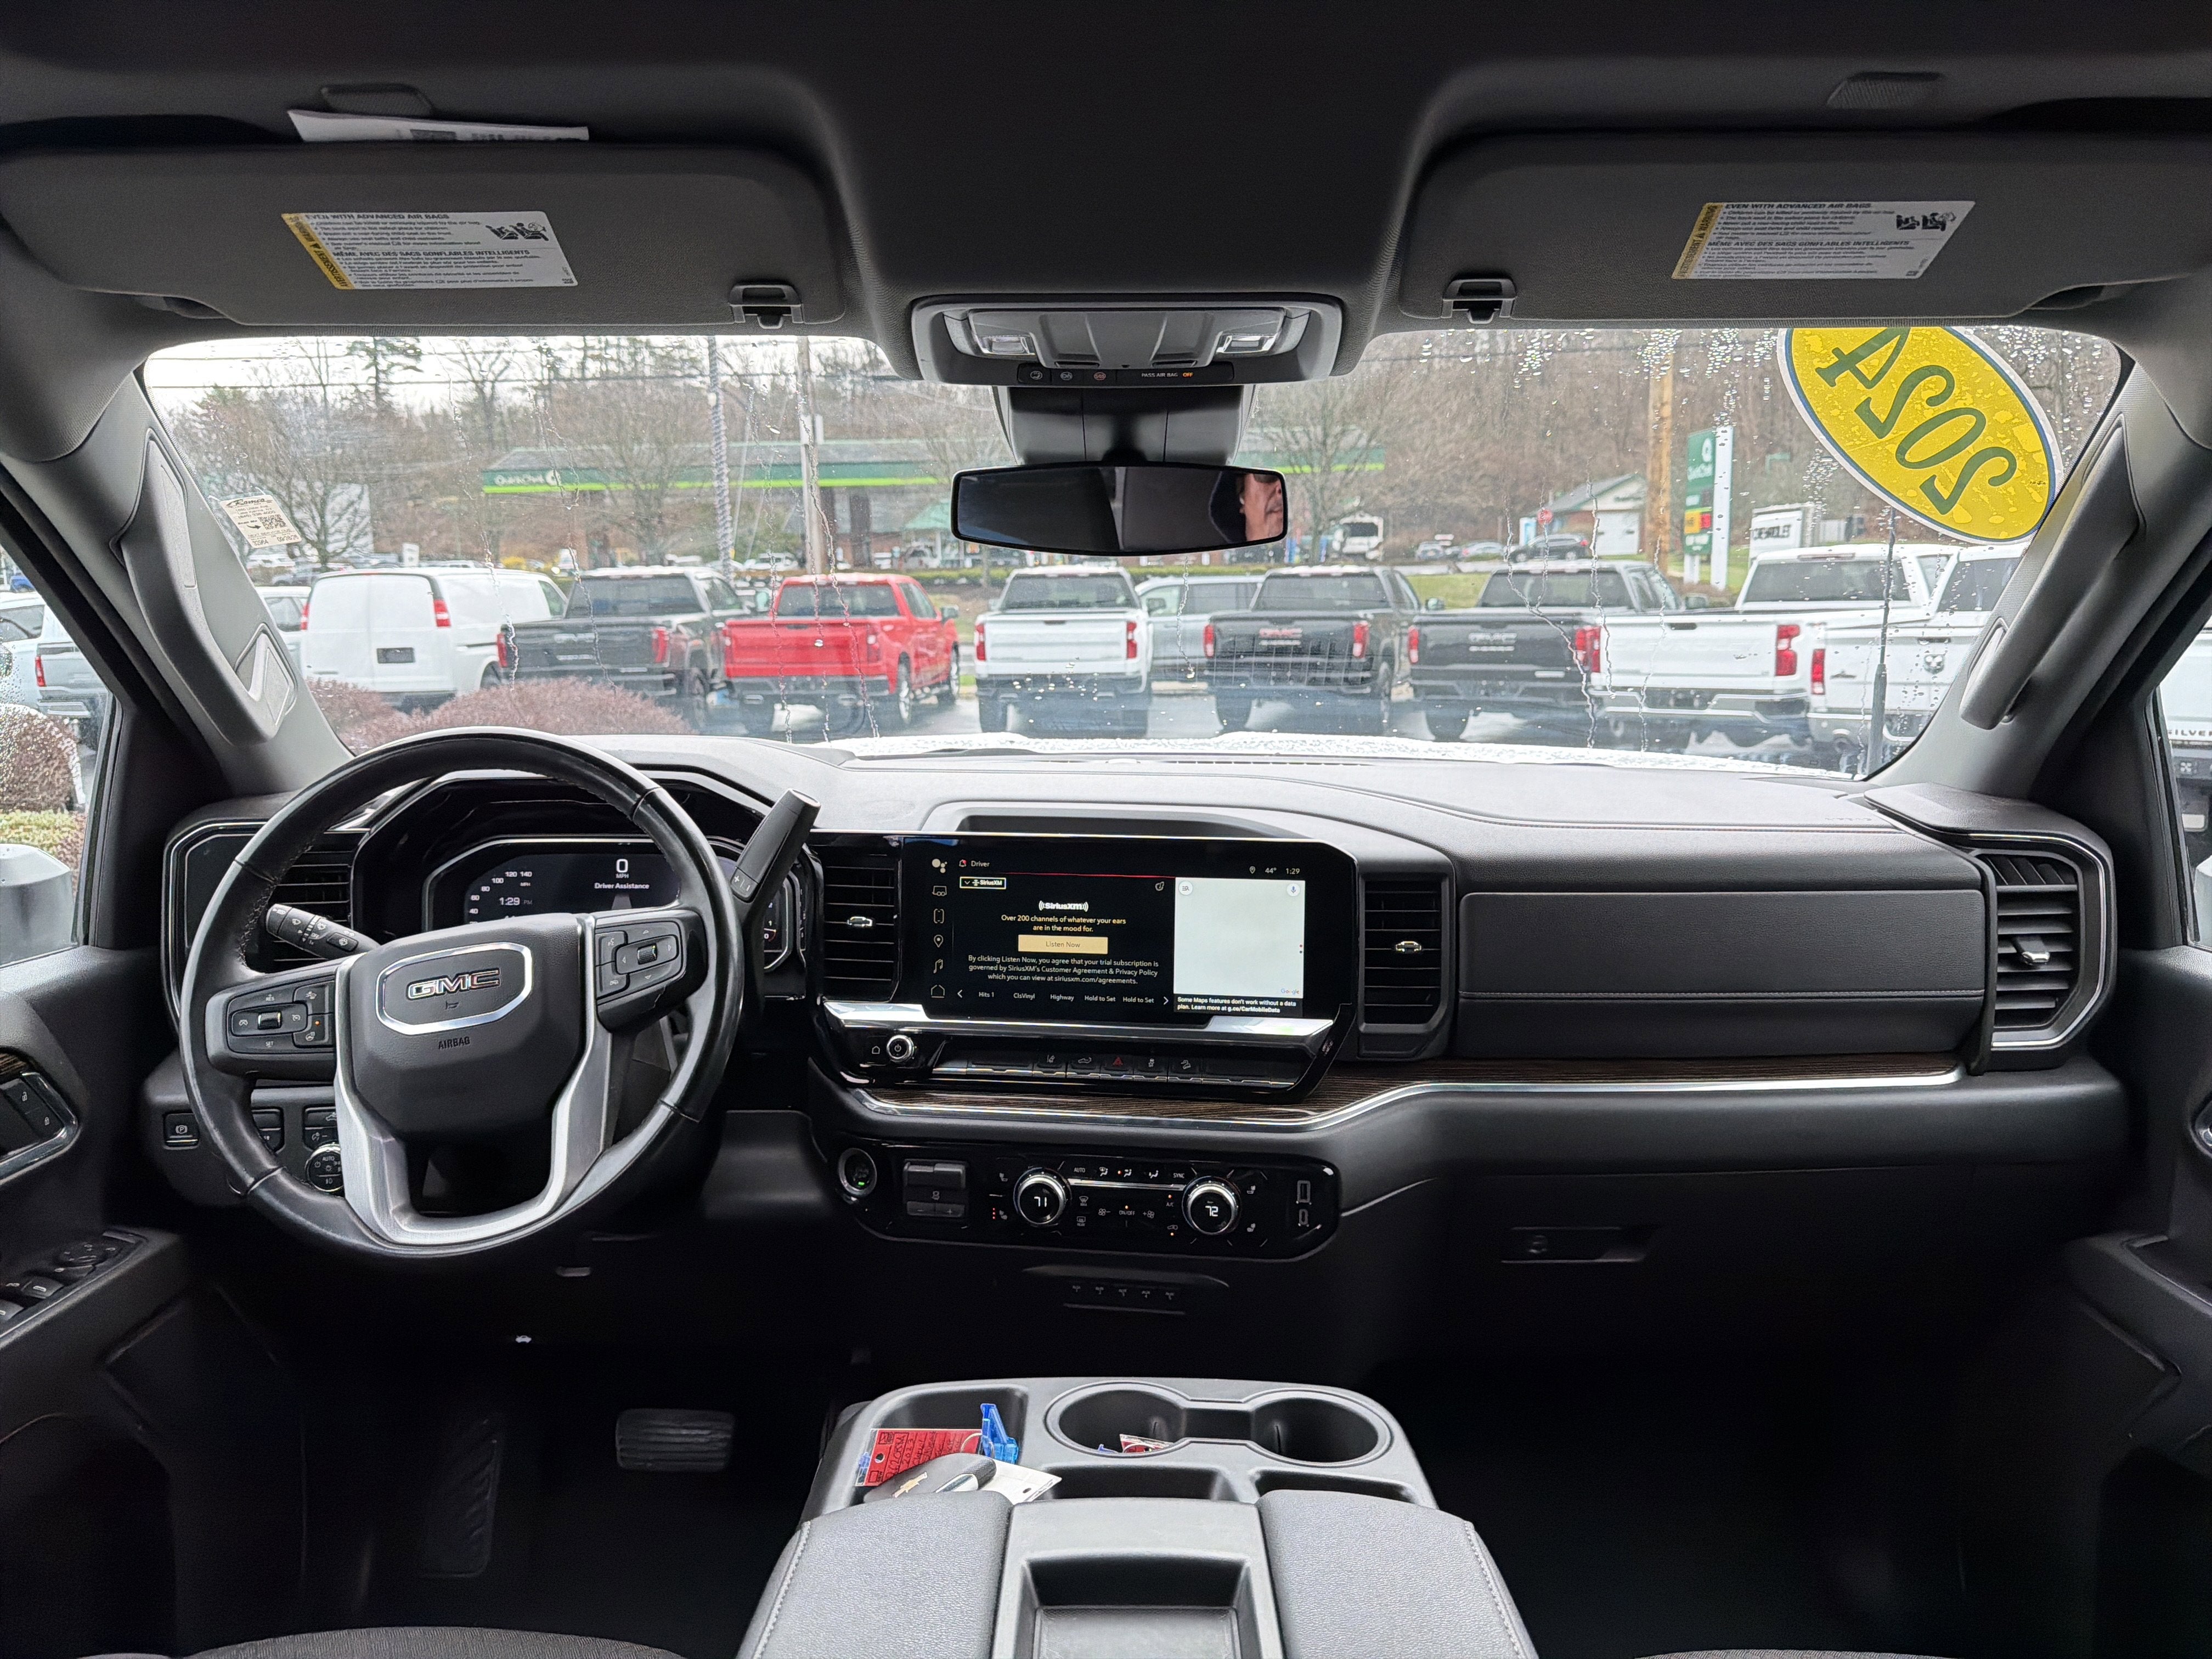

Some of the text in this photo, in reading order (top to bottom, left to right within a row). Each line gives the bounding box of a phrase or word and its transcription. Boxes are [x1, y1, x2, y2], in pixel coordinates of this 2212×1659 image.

[1815, 328, 2017, 515] 2024
[616, 859, 628, 873] 0
[499, 897, 521, 905] 1:29
[977, 956, 1001, 964] clicking
[1113, 960, 1152, 968] subscription
[968, 964, 998, 973] governed
[1073, 967, 1108, 975] Agreement
[406, 968, 500, 1000] GMC
[1054, 975, 1138, 985] siriusxm.com/agreements.
[1050, 994, 1074, 1002] Highway
[438, 1036, 470, 1049] AIRBAG
[1205, 1205, 1218, 1217] 72
